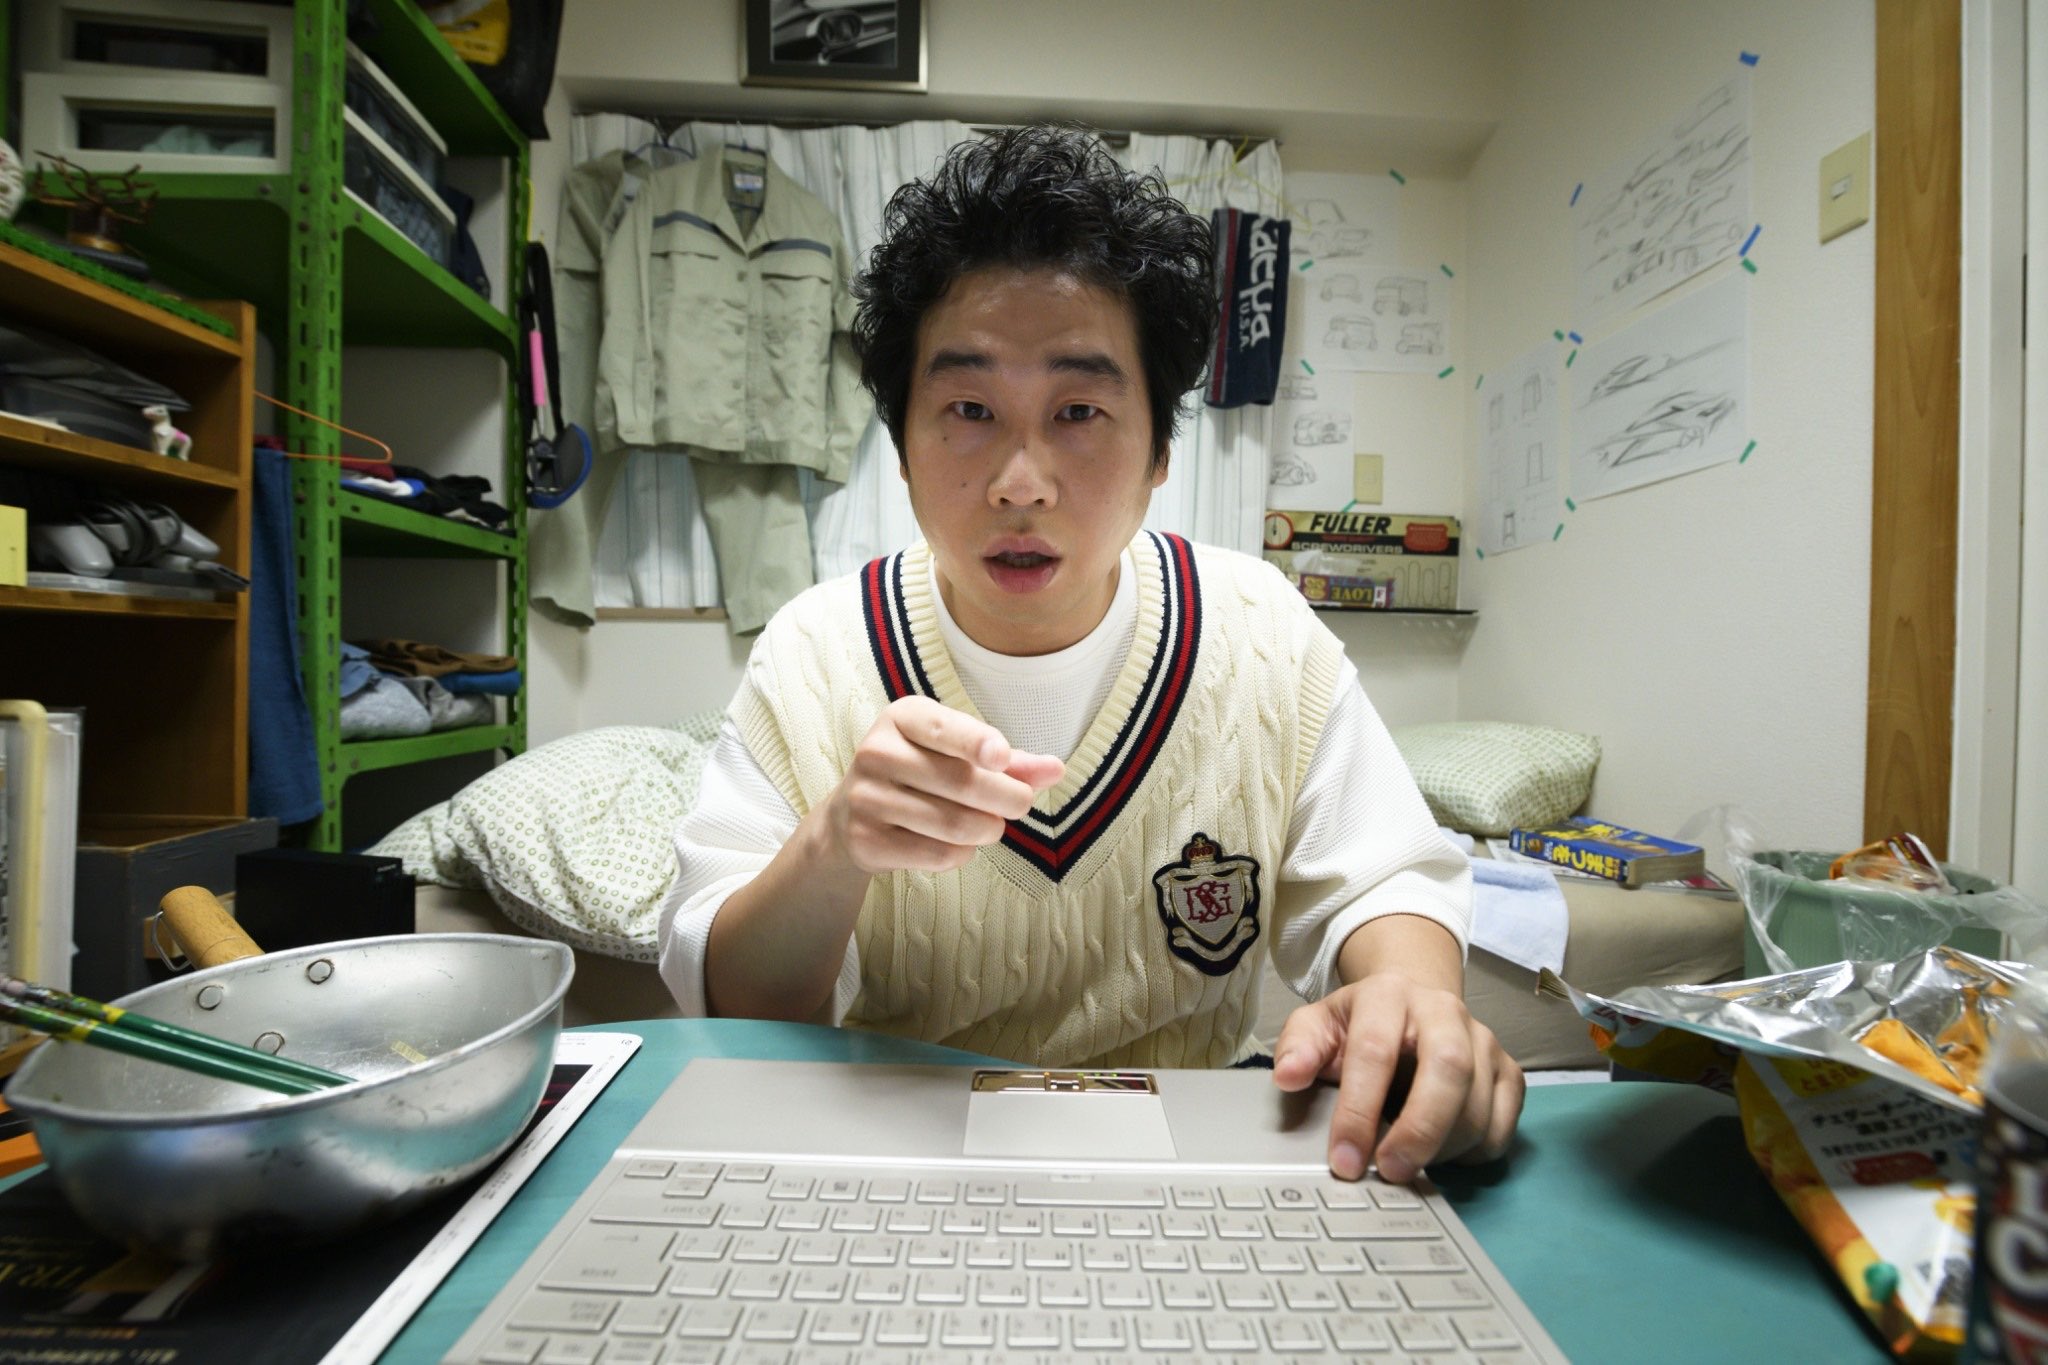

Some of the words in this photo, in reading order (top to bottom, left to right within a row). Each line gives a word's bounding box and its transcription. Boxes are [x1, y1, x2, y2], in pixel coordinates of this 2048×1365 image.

[1310, 513, 1392, 534] FULLER
[1291, 541, 1404, 554] SCREWDRIVERS
[1331, 586, 1372, 600] LOVE
